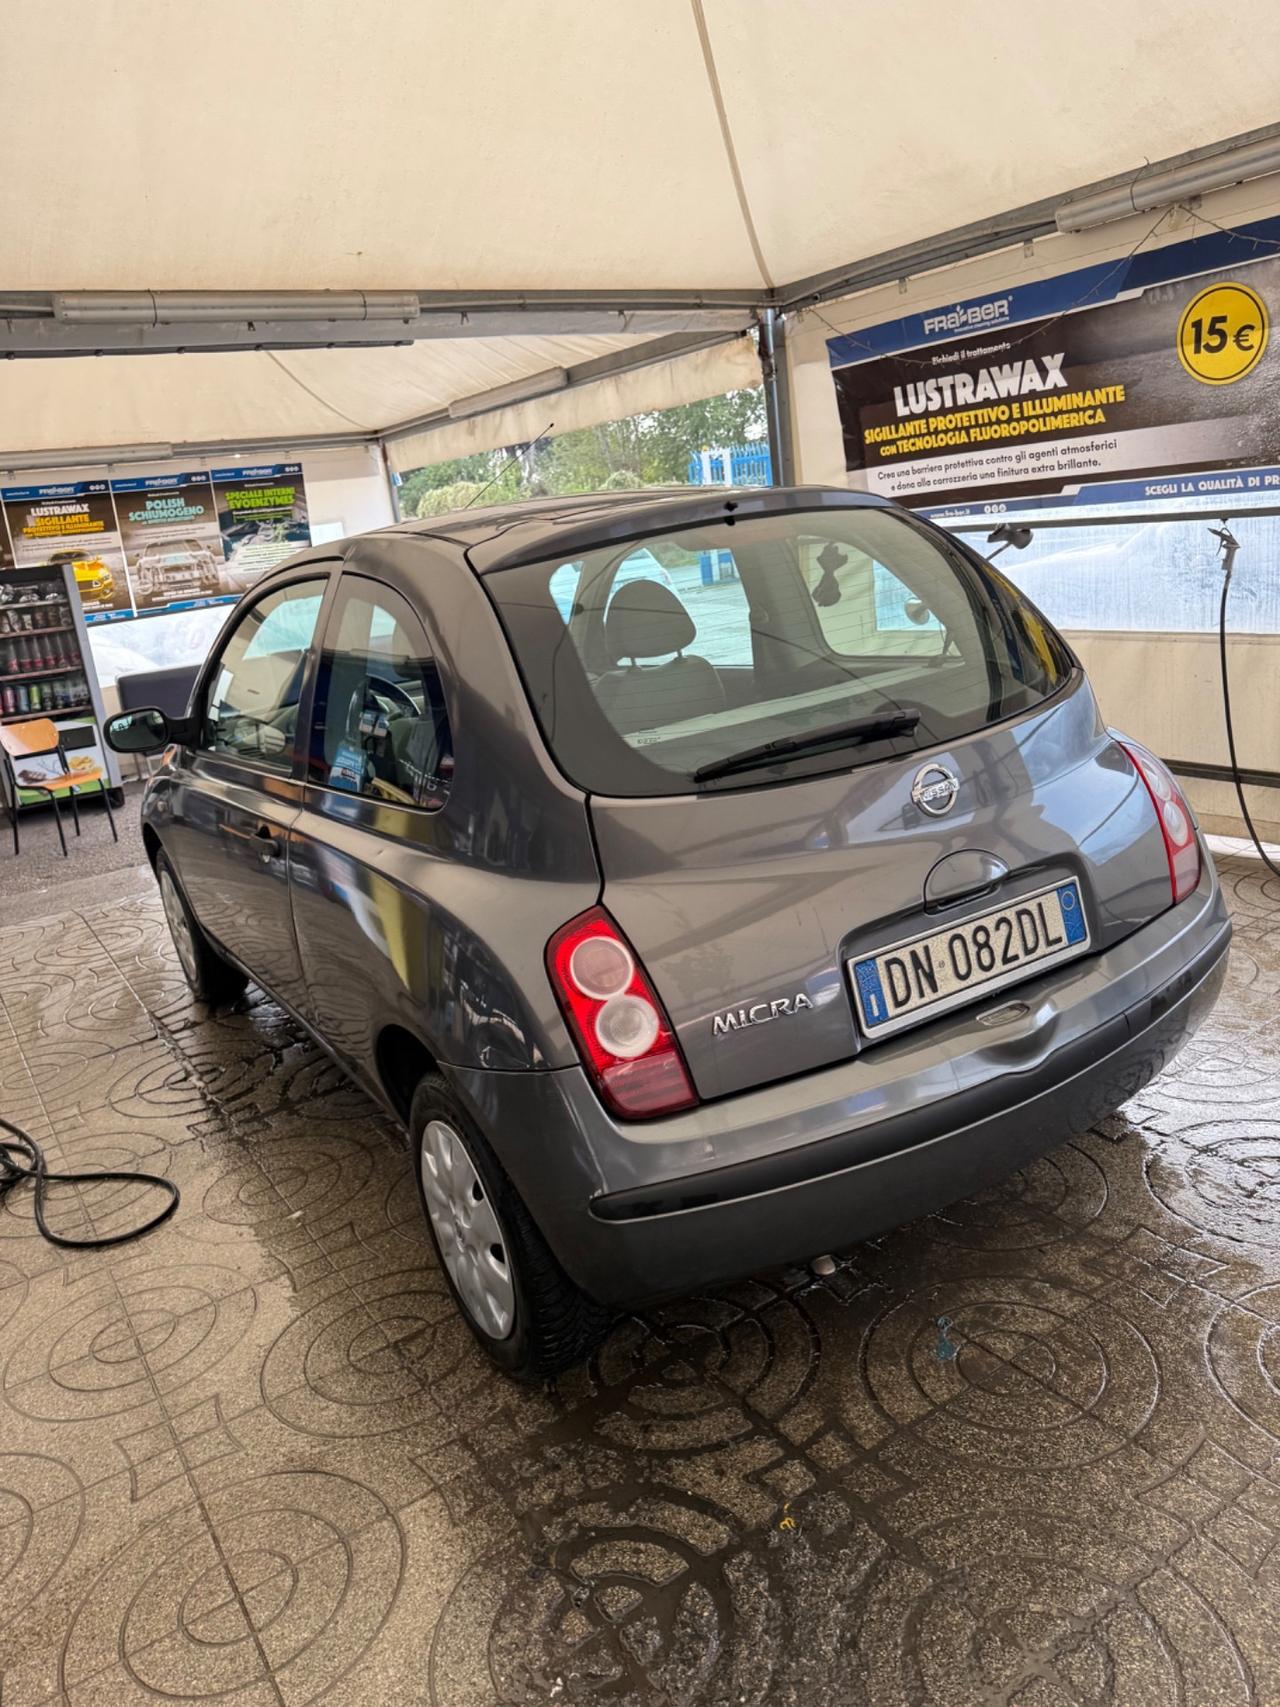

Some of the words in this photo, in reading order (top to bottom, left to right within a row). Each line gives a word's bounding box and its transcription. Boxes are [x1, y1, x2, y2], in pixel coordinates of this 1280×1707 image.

[893, 352, 1068, 417] LUSTRAWAX
[864, 419, 928, 444] SIGILLANTE
[929, 406, 1009, 432] PROTETTIVO
[1012, 404, 1021, 418] E
[1023, 385, 1125, 416] ILLUMINANTE
[897, 430, 968, 453] TECNOLOGIA
[970, 409, 1106, 442] FLUOROPOLIMERICA
[878, 471, 895, 480] Crea
[897, 469, 910, 477] una
[911, 465, 943, 475] barriera
[944, 458, 984, 472] protettiva
[985, 454, 1013, 464] contro
[1015, 451, 1027, 463] gli
[1029, 447, 1059, 461] agenti
[1060, 439, 1117, 455] atmosferici
[897, 481, 915, 490] dona
[917, 478, 931, 487] alla
[933, 473, 978, 485] carrozzeria
[997, 465, 1029, 477] finitura
[1031, 463, 1055, 473] extra
[1057, 458, 1102, 471] brillante.
[1145, 484, 1177, 495] SCEGLI
[1181, 481, 1195, 492] LA
[1198, 475, 1243, 491] QUALITÀ
[1248, 476, 1260, 487] DI
[1264, 474, 1280, 486] PR
[31, 503, 90, 516] LUSTRAWAX
[35, 514, 90, 526] SIGILLANTE
[128, 506, 204, 521] SCHIUMOGENO
[145, 498, 184, 510] POLISH
[918, 779, 958, 802] NISSAN
[884, 945, 939, 1009] DN
[948, 902, 1064, 981] 082DL
[712, 993, 814, 1035] MICRA
